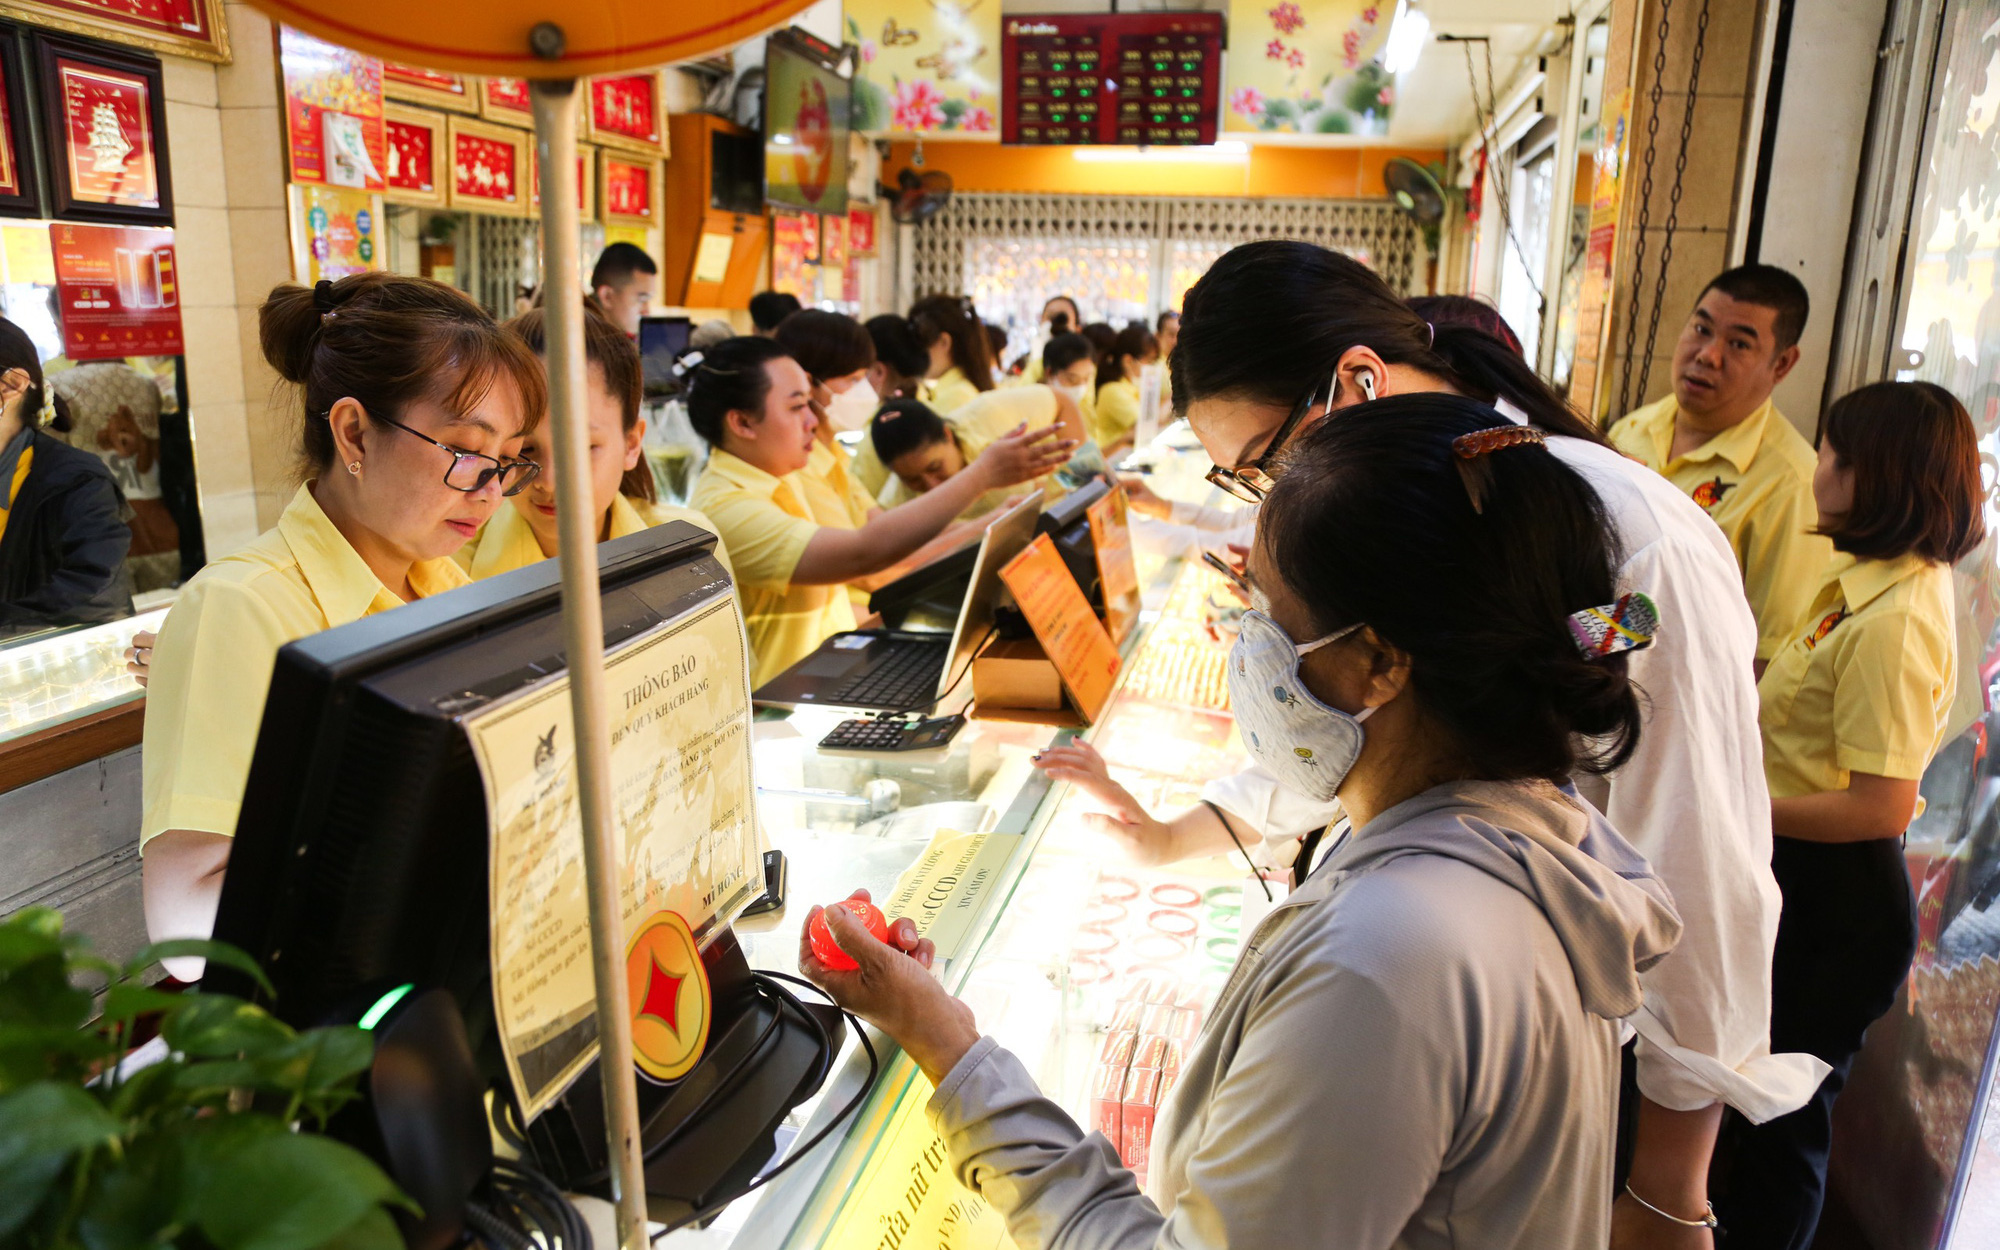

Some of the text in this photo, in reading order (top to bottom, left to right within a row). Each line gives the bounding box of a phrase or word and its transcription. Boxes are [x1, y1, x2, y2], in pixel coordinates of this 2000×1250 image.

[624, 654, 696, 709] THÔNG BÁO
[655, 692, 685, 719] KHÁCH
[686, 677, 708, 700] HÀNG
[922, 876, 958, 909] CCCD
[905, 1162, 929, 1213] nữ
